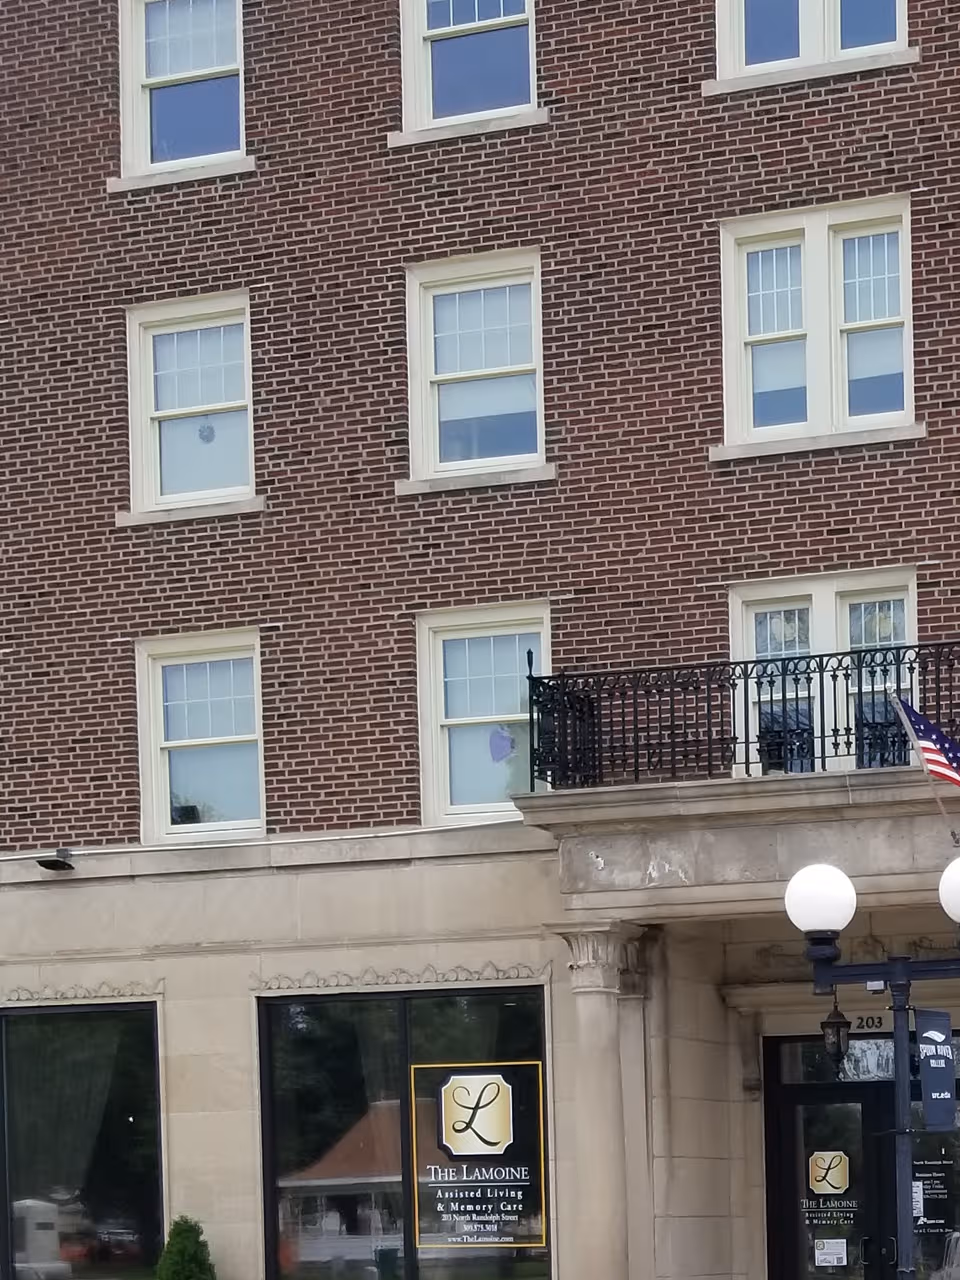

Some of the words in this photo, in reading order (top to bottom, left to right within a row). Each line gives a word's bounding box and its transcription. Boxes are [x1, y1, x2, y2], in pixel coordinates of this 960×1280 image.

[856, 1016, 883, 1029] 203
[426, 1164, 458, 1181] THE
[461, 1164, 530, 1181] LAMOINE
[436, 1188, 482, 1199] Assisted
[487, 1188, 523, 1200] Living
[436, 1202, 445, 1212] &
[450, 1202, 494, 1213] Memory
[500, 1201, 523, 1211] Care
[819, 1198, 858, 1209] LAMOINE
